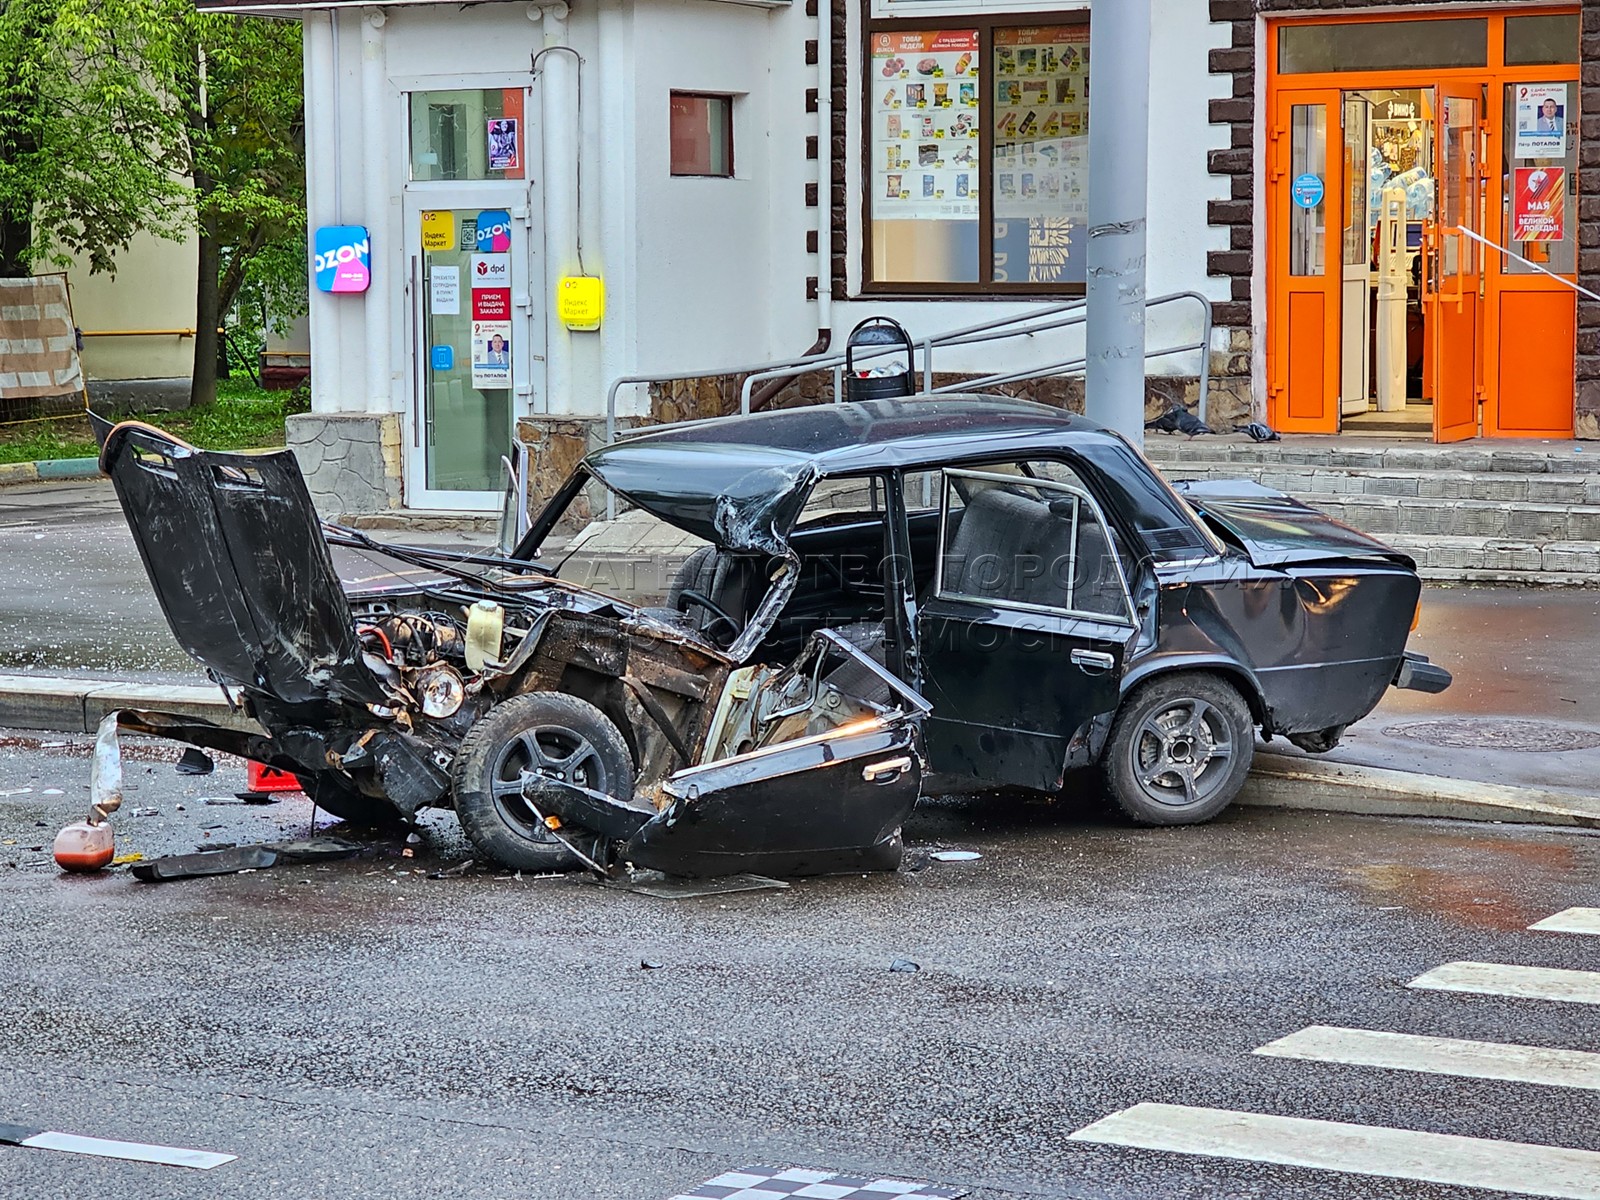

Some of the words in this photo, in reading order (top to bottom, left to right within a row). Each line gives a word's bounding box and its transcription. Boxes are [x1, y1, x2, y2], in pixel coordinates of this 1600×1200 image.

[1527, 201, 1550, 211] МАЯ
[1519, 215, 1554, 225] ВЕЛИКОЙ
[424, 232, 446, 240] Яндекс
[477, 221, 511, 241] OZON
[315, 238, 369, 273] OZON
[490, 264, 505, 274] dpd
[564, 298, 588, 306] Яндекс
[564, 308, 588, 316] Маркет
